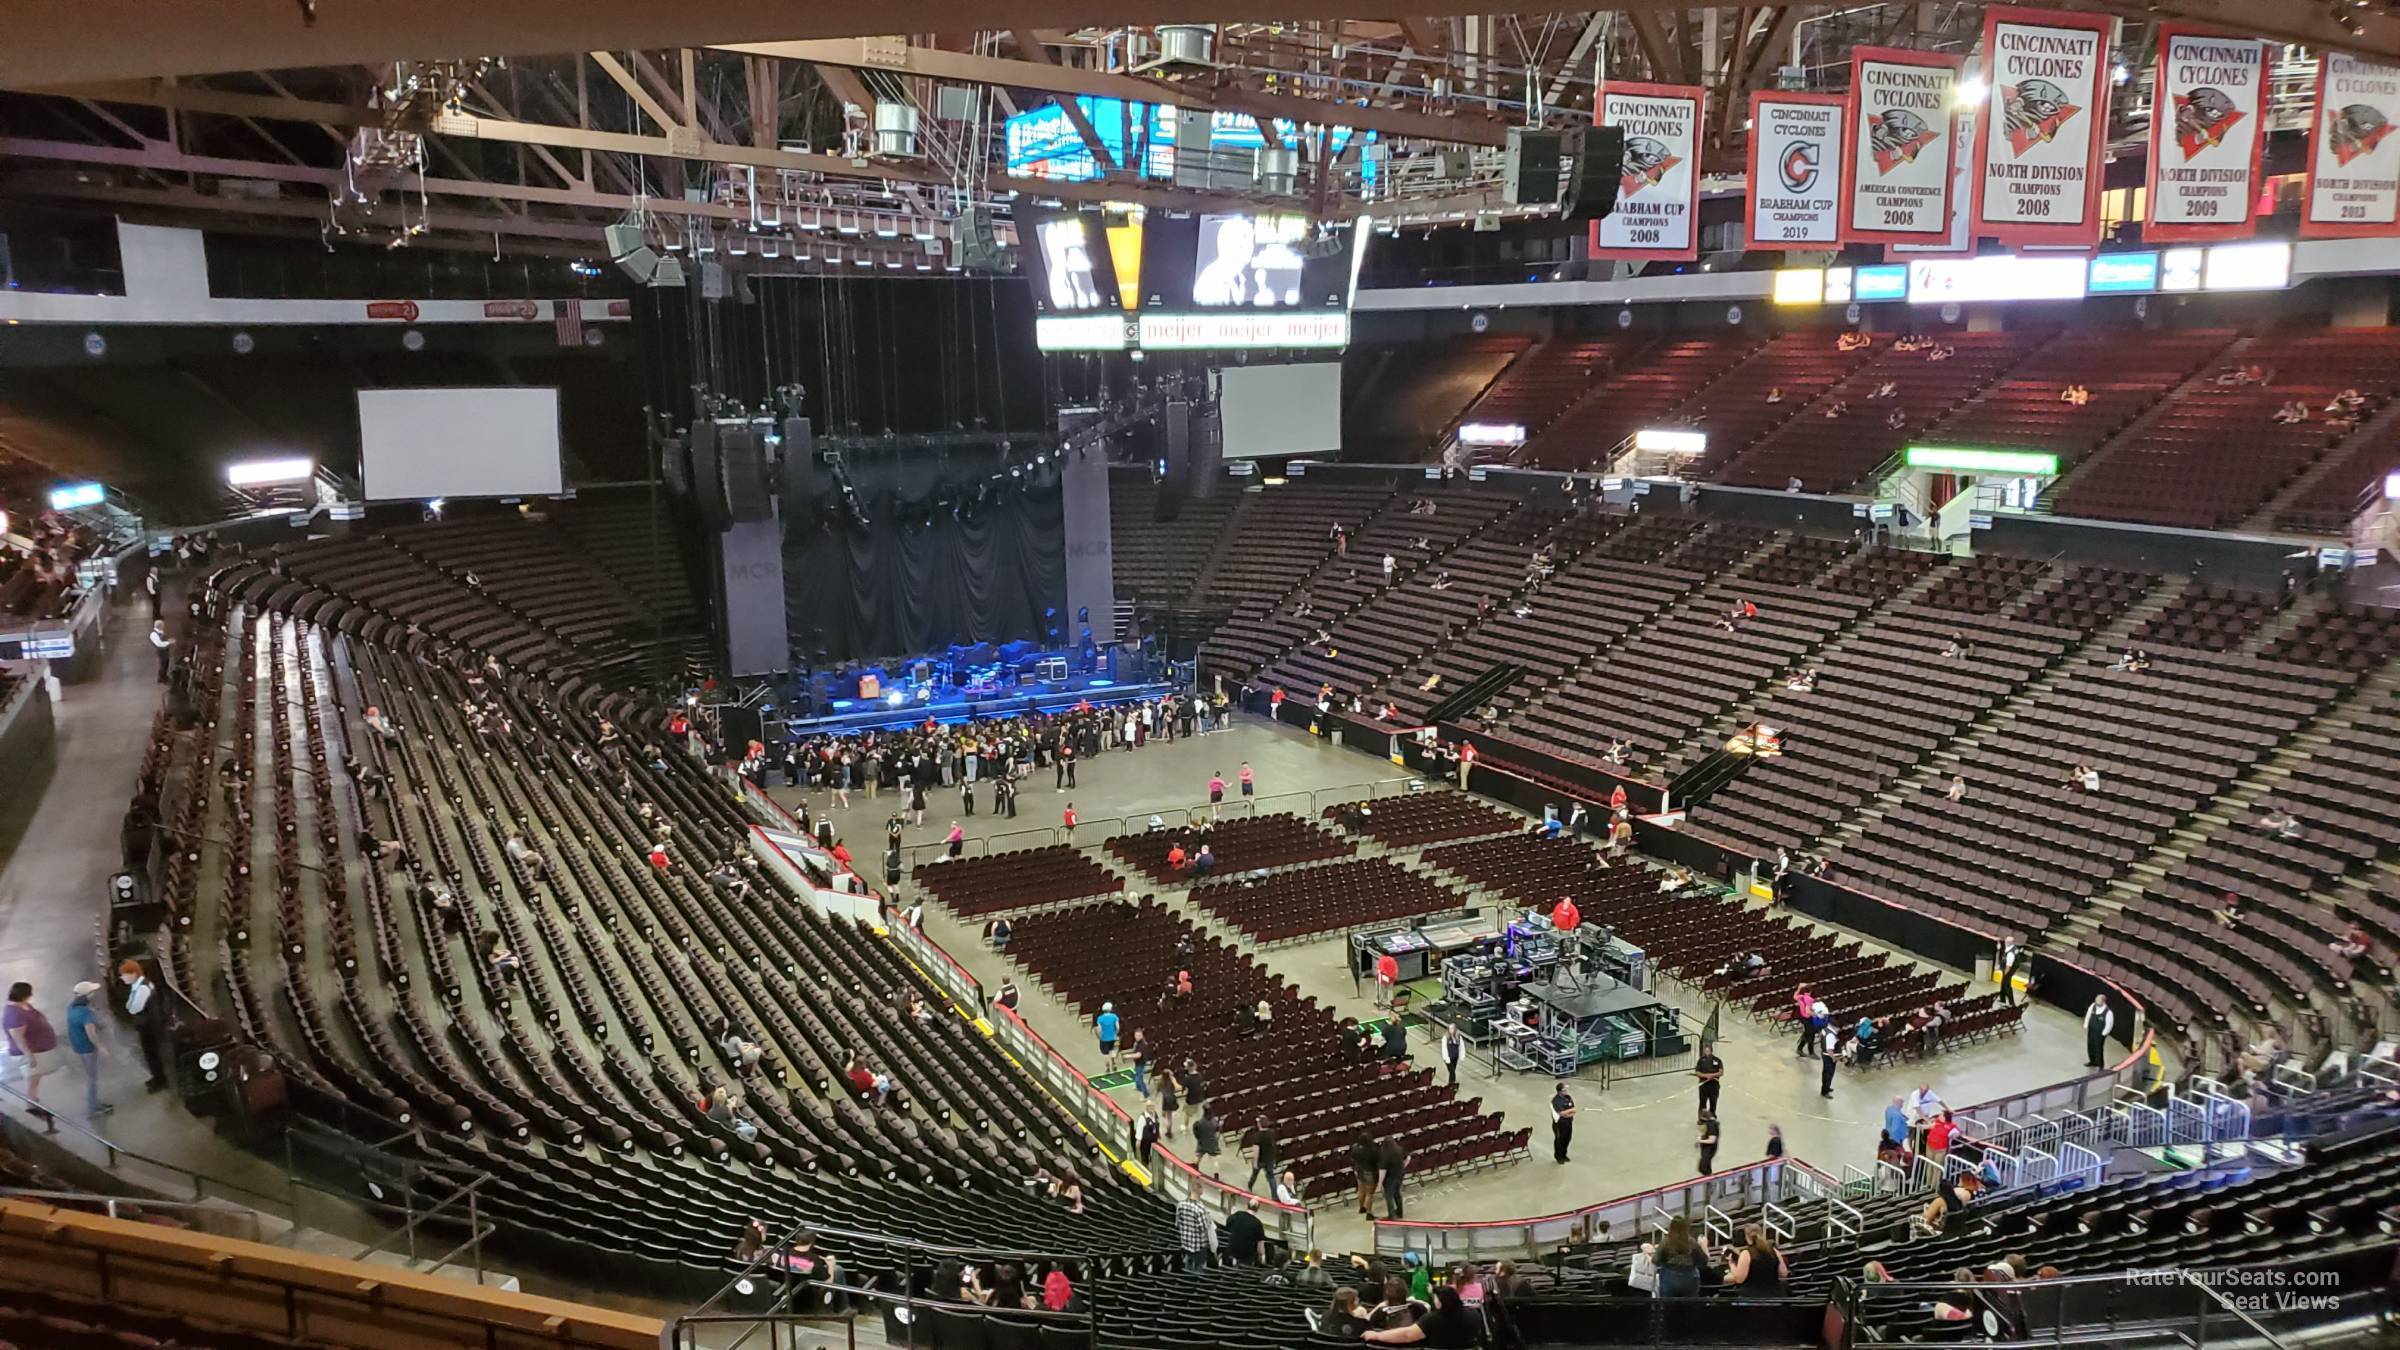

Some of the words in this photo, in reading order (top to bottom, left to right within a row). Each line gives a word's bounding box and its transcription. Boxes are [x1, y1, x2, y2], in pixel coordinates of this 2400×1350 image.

[2001, 33, 2093, 56] CINCINNATI
[2173, 45, 2258, 65] CINCINNATI
[2007, 56, 2083, 79] CYCLONES
[2179, 65, 2248, 86] CYCLONES
[1867, 71, 1950, 88] CINCINNATI
[1874, 89, 1941, 109] CYCLONES
[1609, 102, 1690, 119] CINCINNATI
[1771, 109, 1830, 122] CINCINNATI
[1774, 123, 1826, 136] CYCLONES
[1989, 163, 2027, 180] NORTH
[2030, 166, 2084, 181] DIVISION
[2160, 167, 2197, 182] NORTH
[1860, 184, 1897, 194] AMERICAN
[1898, 185, 1942, 196] CONFERENCE
[2009, 183, 2061, 196] CHAMPIONS
[2179, 186, 2227, 197] CHAMPIONS
[1812, 199, 1833, 210] CUP
[1876, 196, 1923, 207] CHAMPIONS
[2017, 199, 2050, 216] 2008
[2187, 200, 2218, 216] 2009
[1665, 204, 1684, 216] CUP
[1773, 212, 1819, 221] CHAMPIONS
[1884, 210, 1914, 226] 2008
[1622, 217, 1669, 226] CHAMPIONS
[1630, 229, 1660, 243] 2008
[1783, 226, 1808, 239] 2019
[1147, 318, 1203, 343] meijer
[1287, 317, 1341, 340] meijer
[1067, 541, 1108, 558] MCR
[729, 562, 778, 580] MCR
